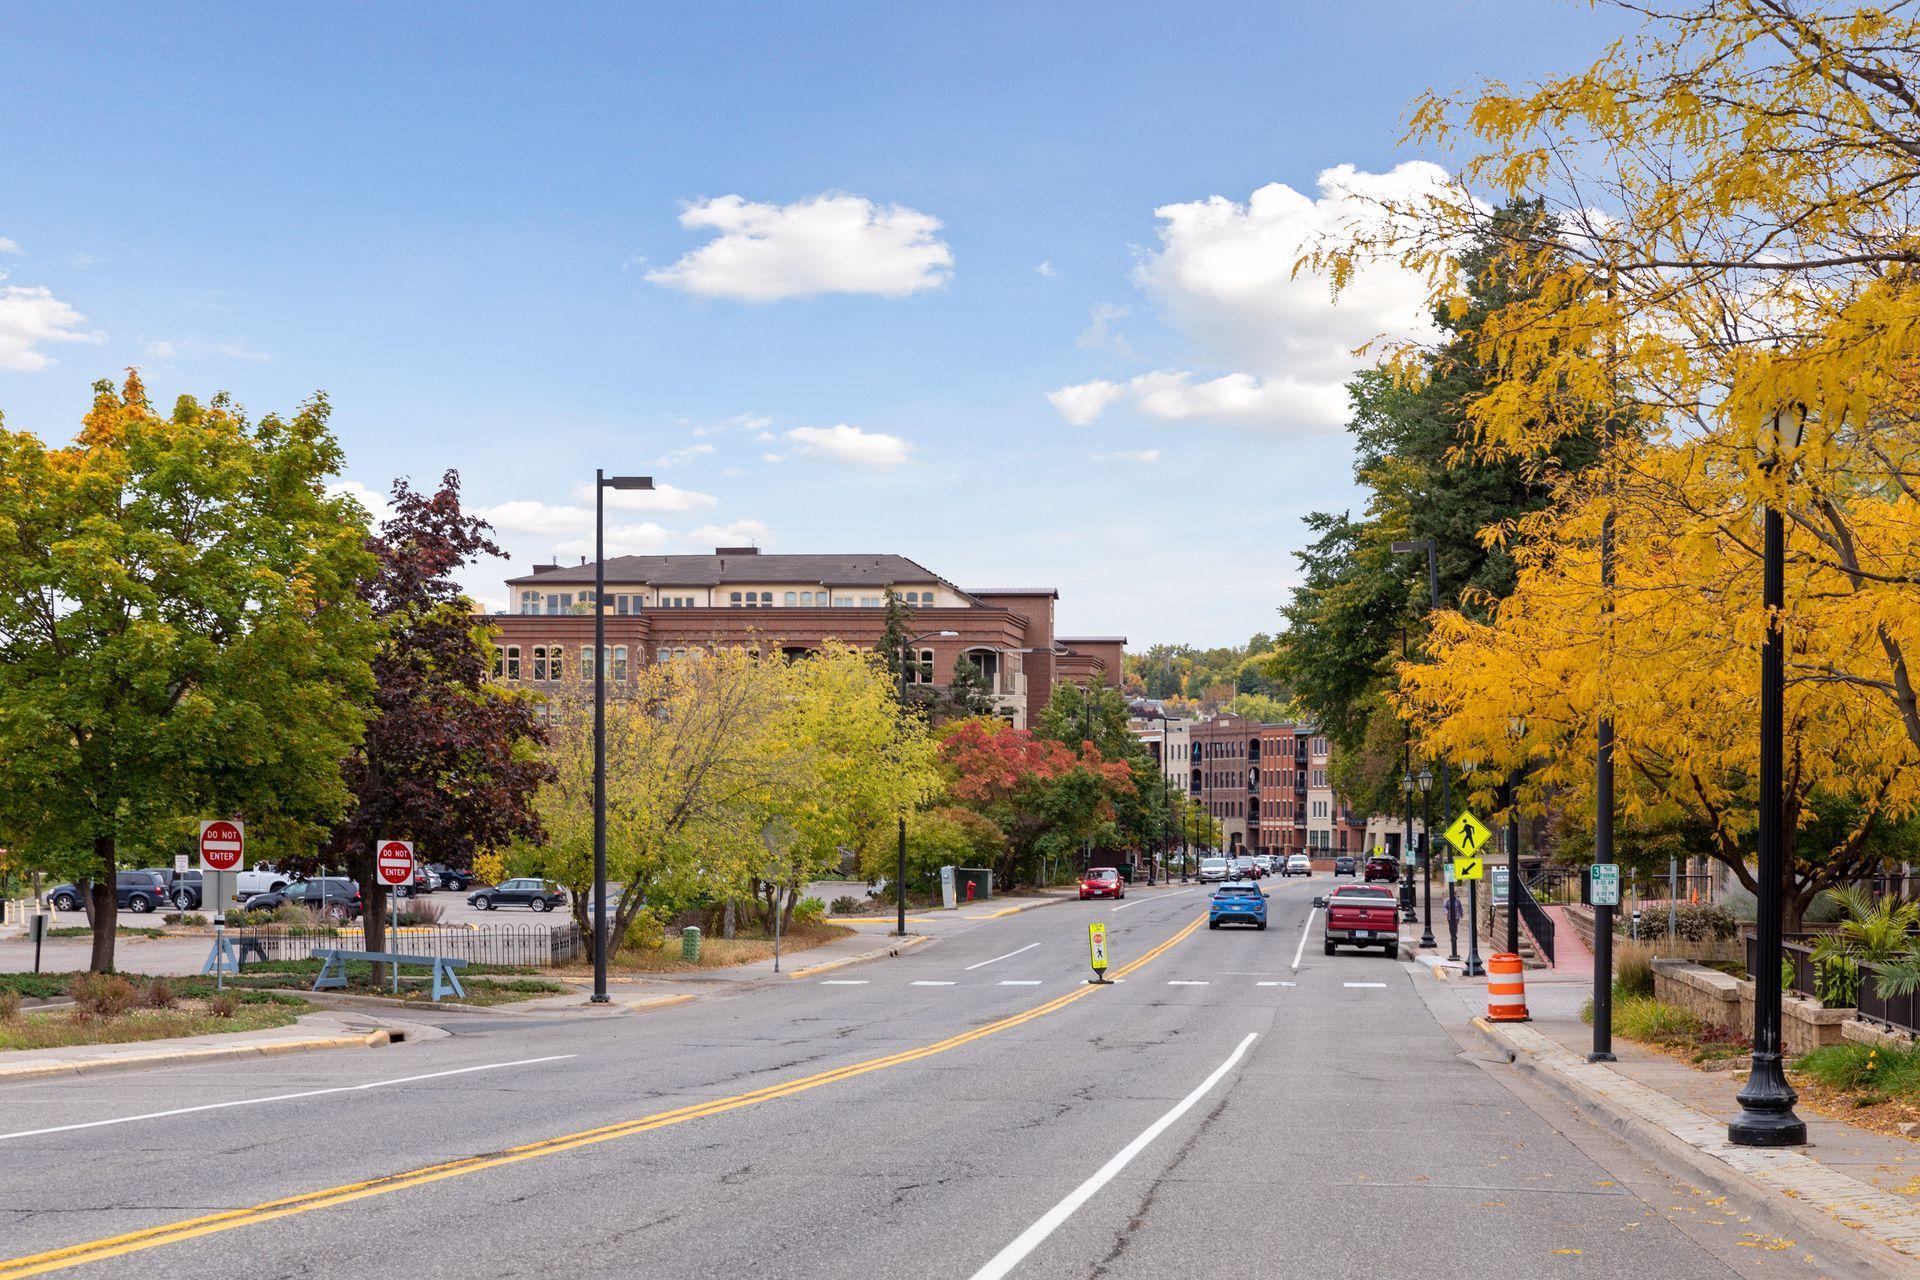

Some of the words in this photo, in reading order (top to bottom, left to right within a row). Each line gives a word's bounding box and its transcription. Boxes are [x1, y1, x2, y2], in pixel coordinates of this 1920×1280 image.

[207, 831, 218, 839] DO
[222, 831, 237, 839] NOT
[209, 852, 234, 861] ENTER
[385, 868, 406, 876] ENTER
[1594, 867, 1599, 877] 3
